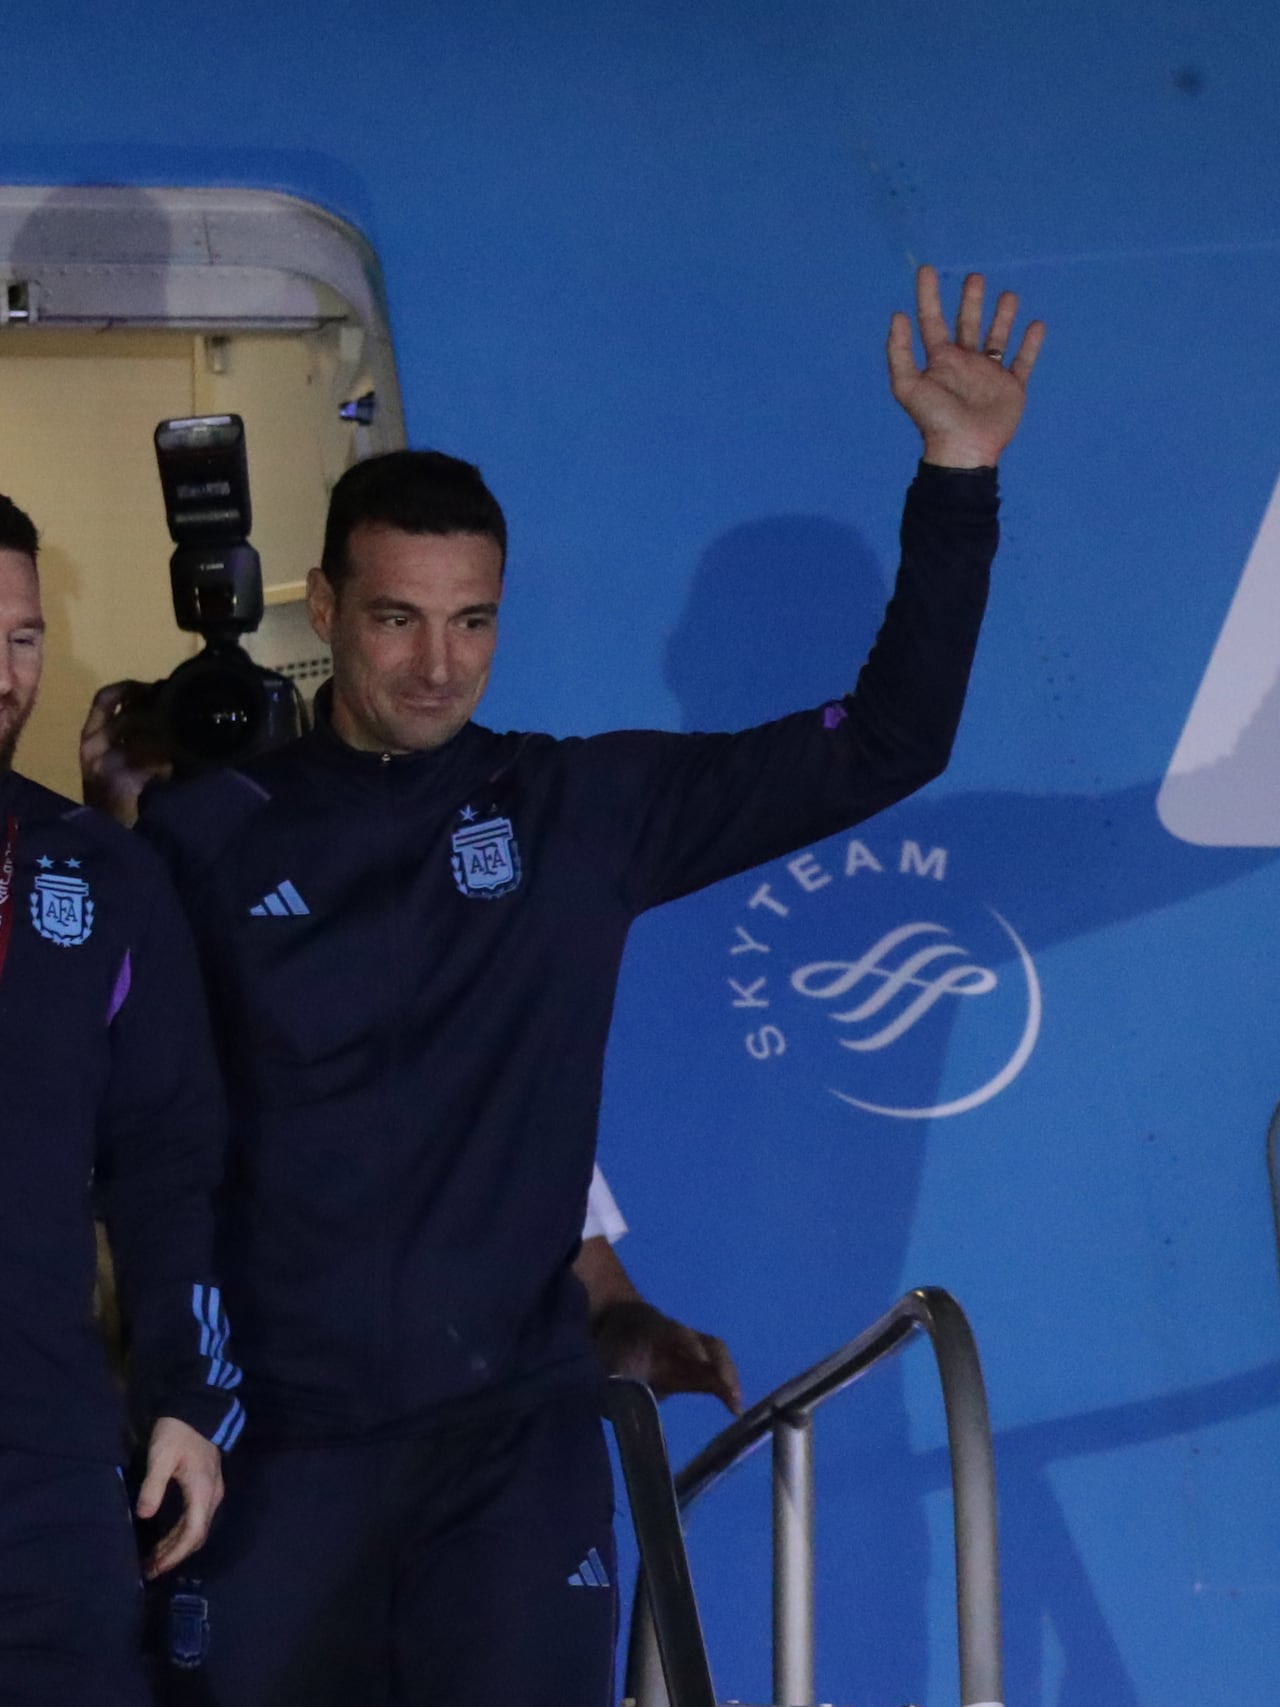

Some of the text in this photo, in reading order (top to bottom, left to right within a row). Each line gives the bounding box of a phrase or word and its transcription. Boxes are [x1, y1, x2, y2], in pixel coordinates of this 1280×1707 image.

[470, 842, 506, 875] AFA
[46, 893, 78, 927] AFA
[728, 839, 948, 1060] SKYTEAM
